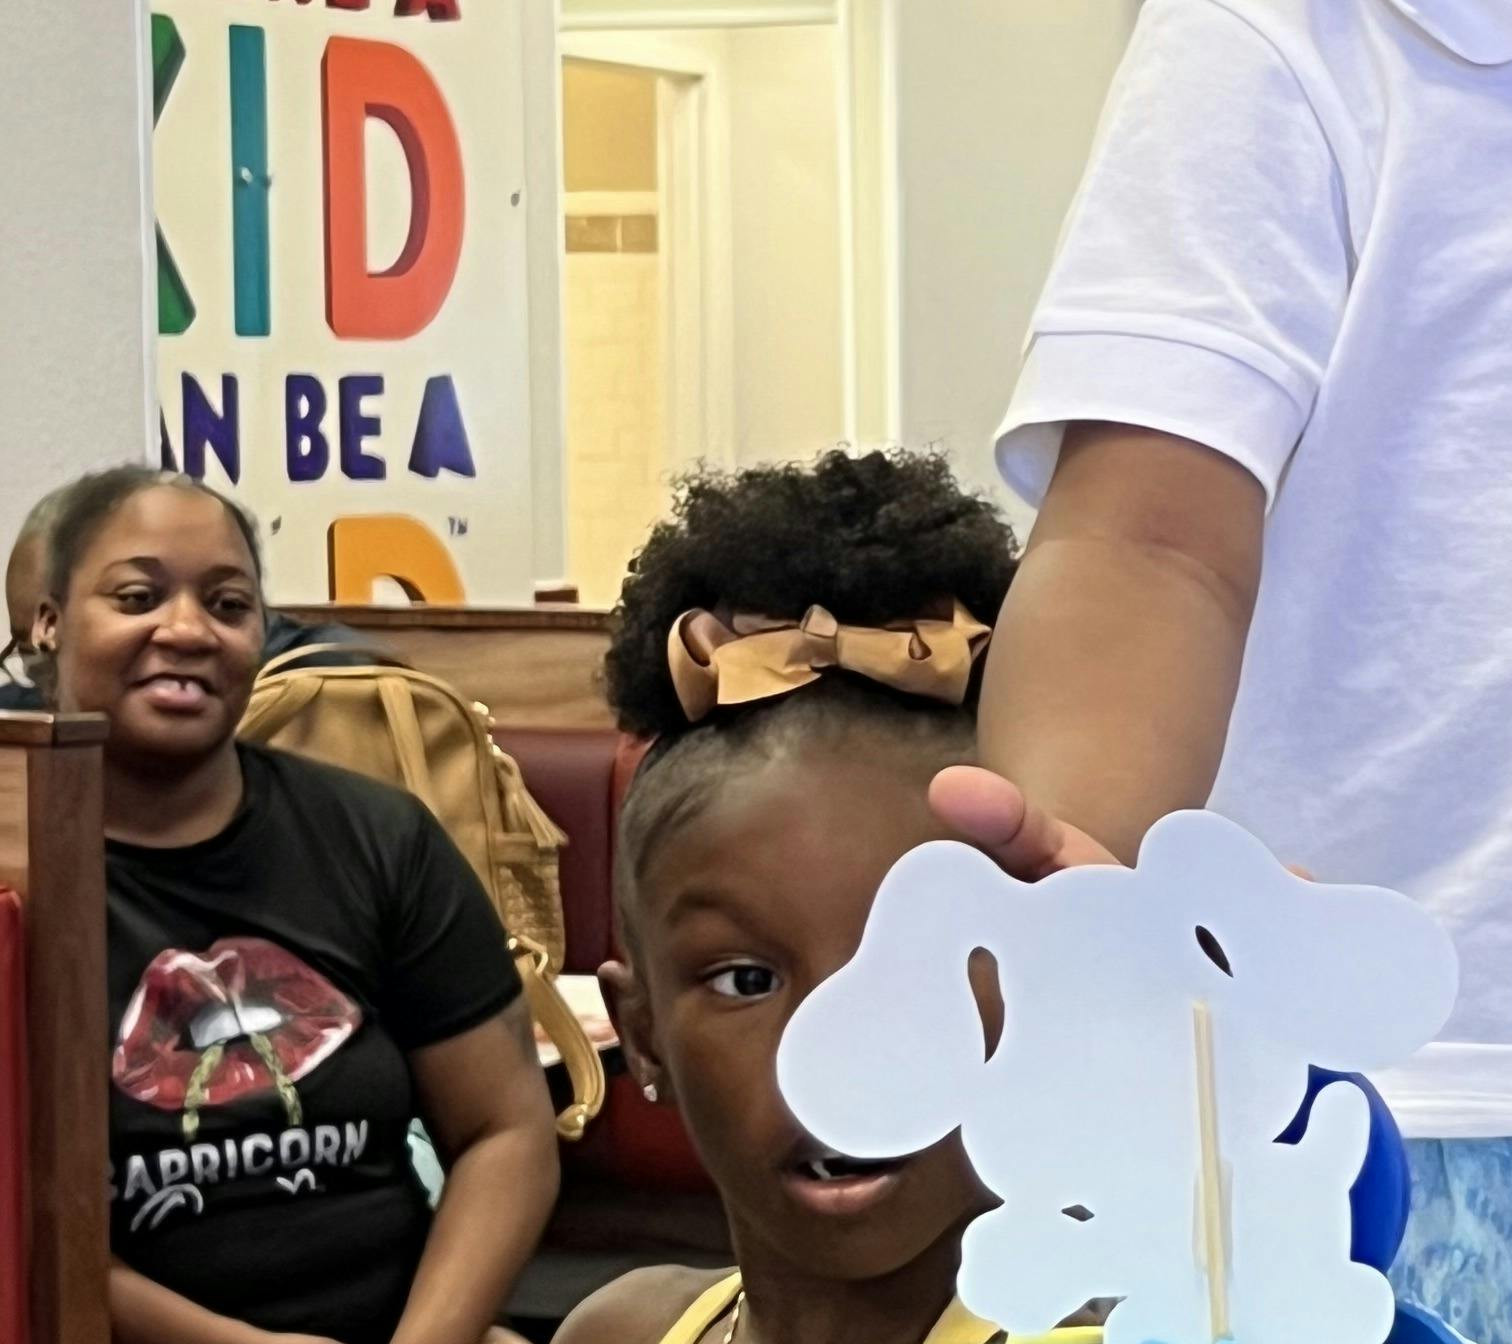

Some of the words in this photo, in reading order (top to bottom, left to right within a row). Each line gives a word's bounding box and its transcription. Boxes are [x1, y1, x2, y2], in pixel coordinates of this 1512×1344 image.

[285, 372, 387, 482] BE
[407, 372, 477, 479] A
[110, 1119, 369, 1202] APRICORN
